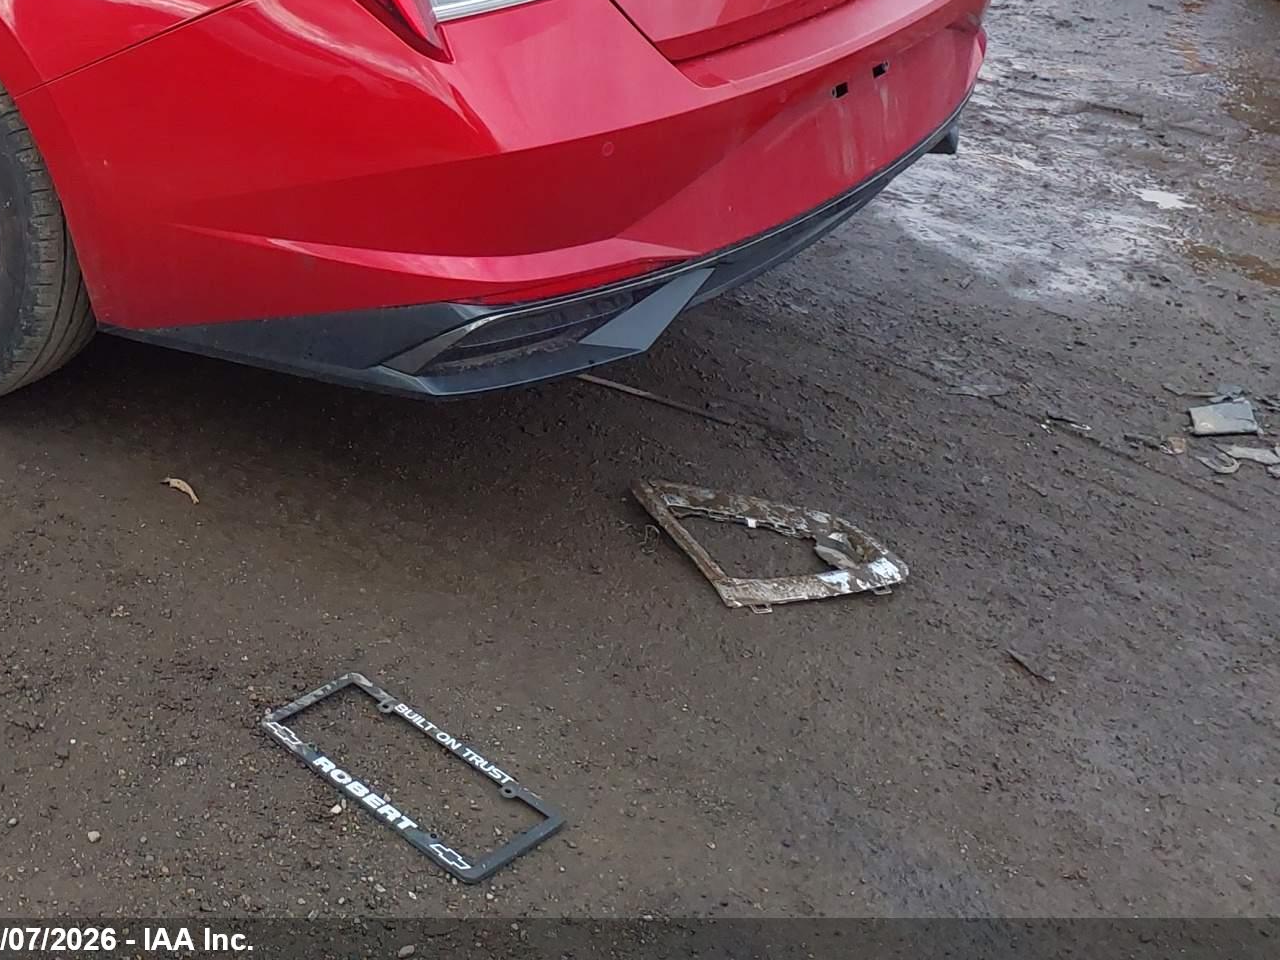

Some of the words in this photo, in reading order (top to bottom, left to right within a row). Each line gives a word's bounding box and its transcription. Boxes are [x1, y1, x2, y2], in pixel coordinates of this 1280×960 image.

[394, 703, 437, 731] BUILT
[436, 732, 462, 750] ON
[462, 747, 515, 784] TRUST
[313, 756, 418, 830] ROBERT
